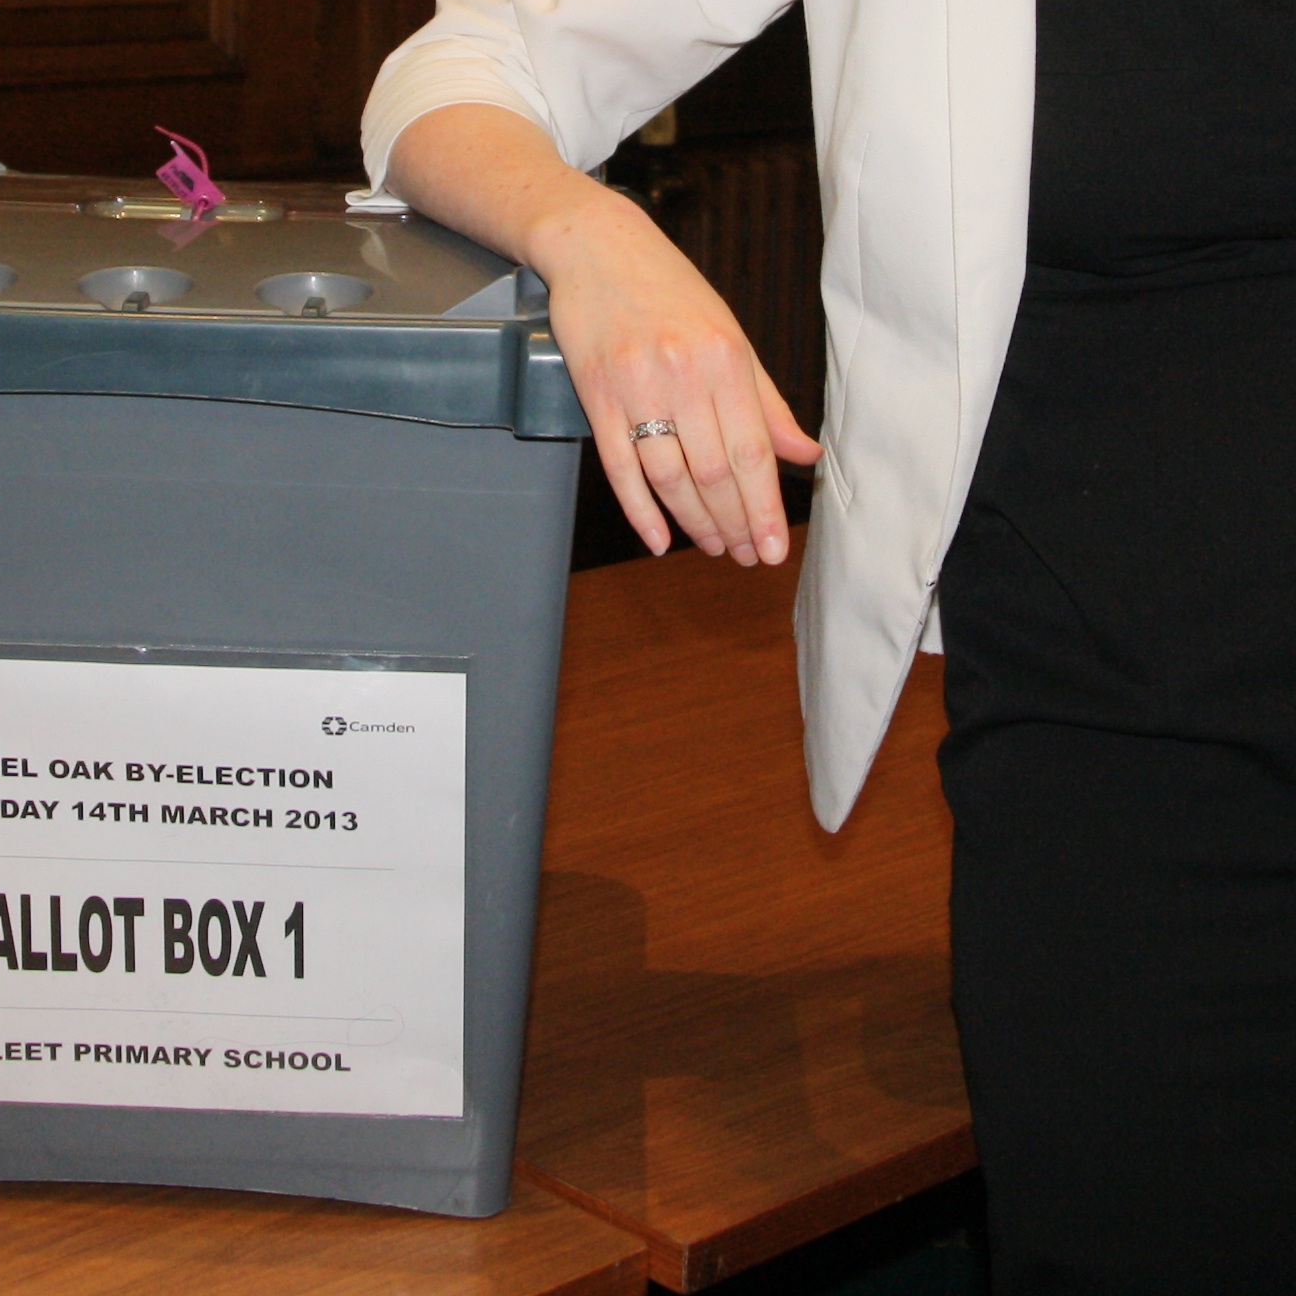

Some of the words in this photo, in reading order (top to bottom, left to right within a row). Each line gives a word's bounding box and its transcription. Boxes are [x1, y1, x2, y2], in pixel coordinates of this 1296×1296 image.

[349, 721, 415, 733] Camden
[48, 759, 114, 781] OAK
[125, 762, 333, 789] BY-ELECTION
[71, 801, 149, 823] 14TH
[161, 804, 273, 828] MARCH
[285, 809, 359, 831] 2013
[163, 898, 267, 978] BOX
[284, 901, 305, 980] 1
[73, 1043, 212, 1067] PRIMARY
[223, 1049, 351, 1072] SCHOOL
